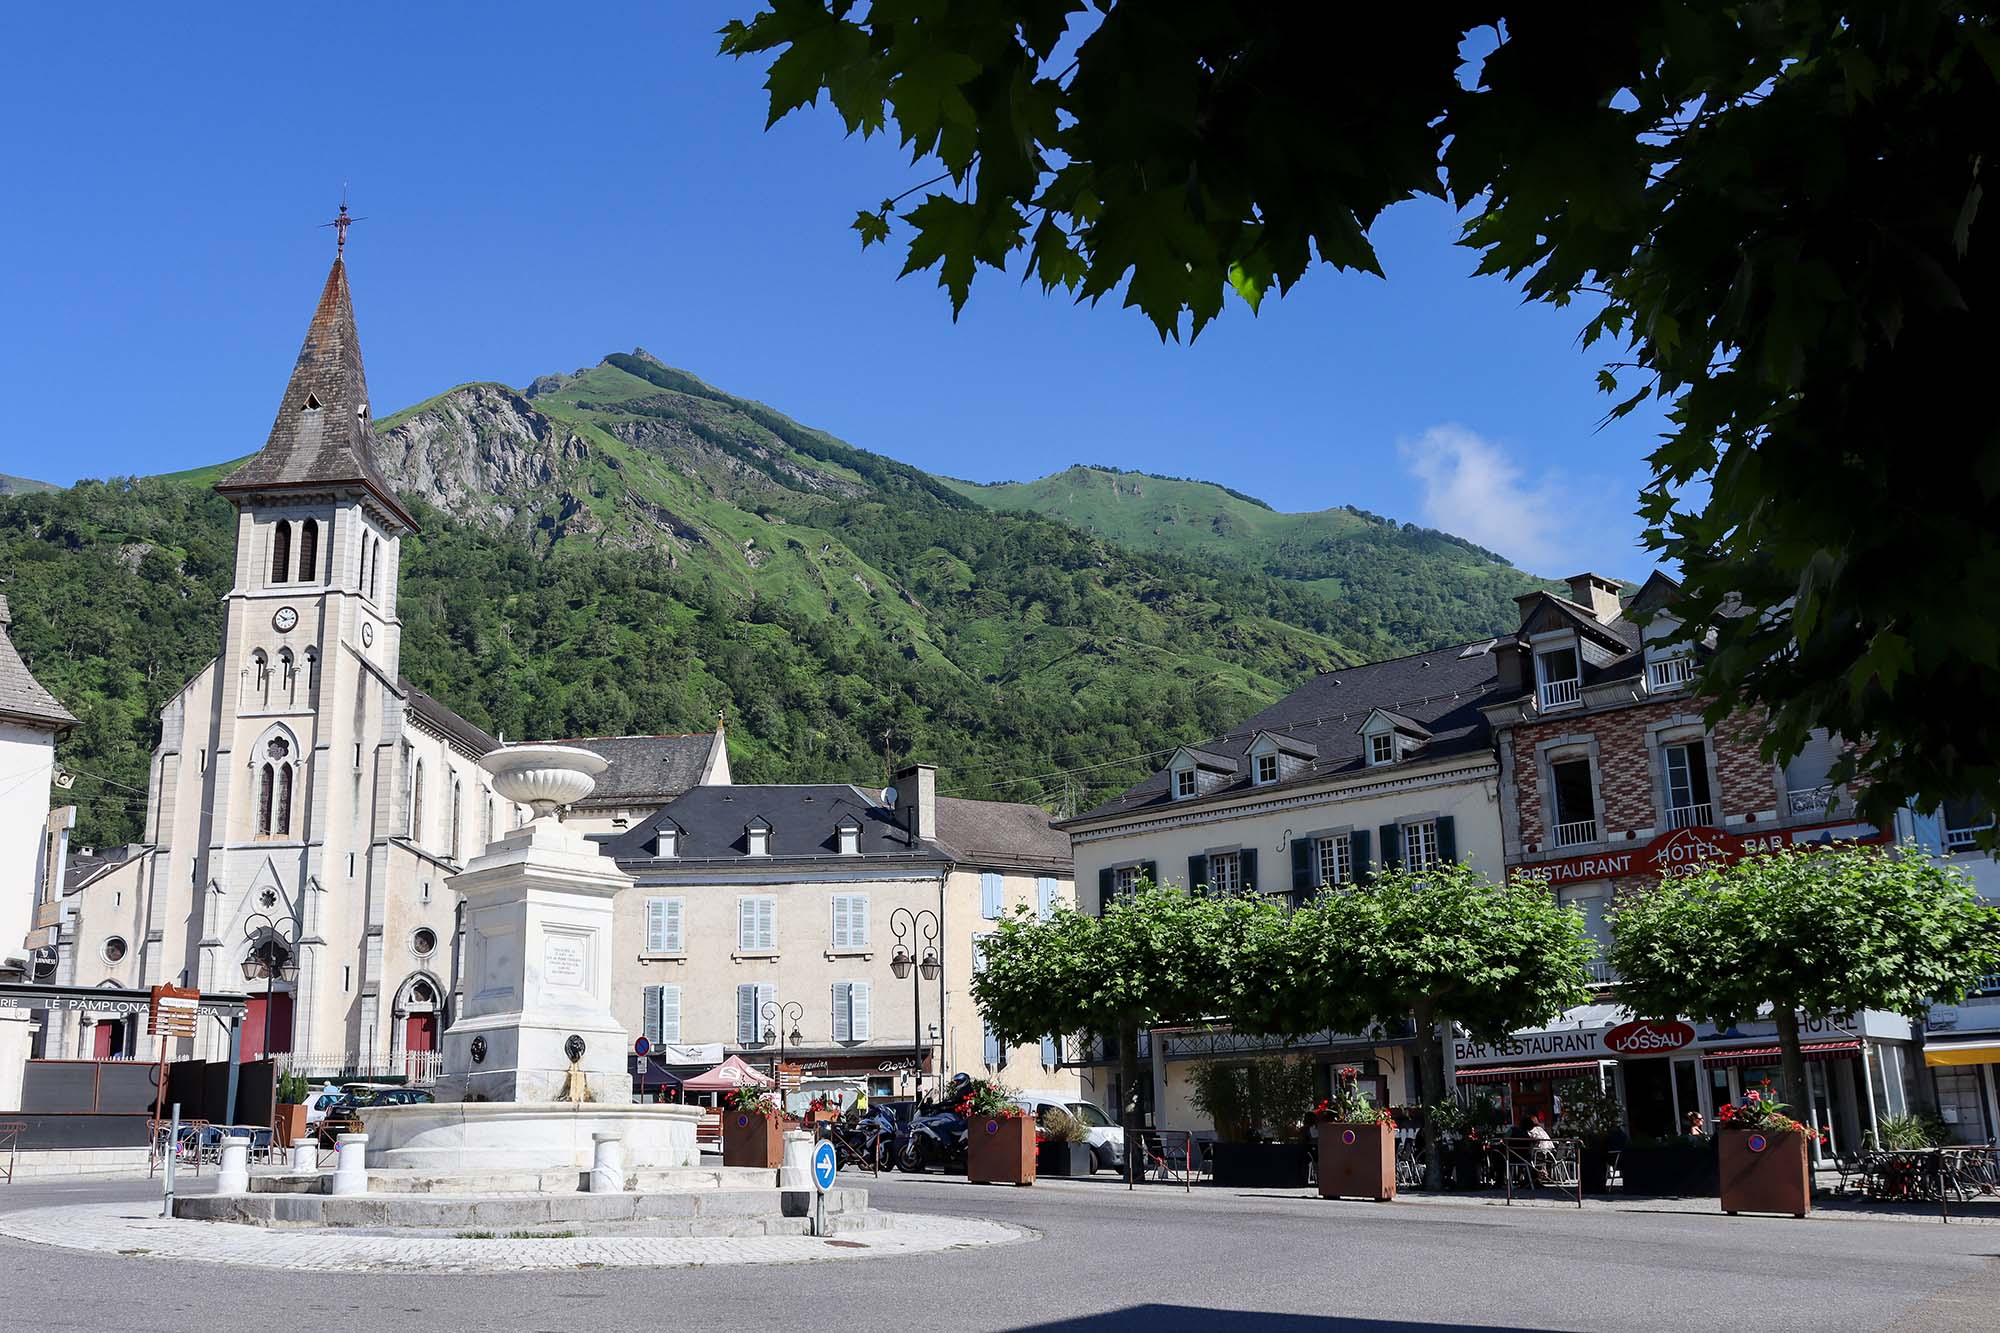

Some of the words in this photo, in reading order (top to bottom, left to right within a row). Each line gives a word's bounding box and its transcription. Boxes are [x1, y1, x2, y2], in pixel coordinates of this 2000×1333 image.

[1520, 855, 1632, 881] RESTAURANT
[1744, 836, 1782, 855] BAR
[1657, 842, 1720, 863] HÔTEL
[69, 1000, 149, 1012] PAMPLONA
[1455, 1042, 1487, 1060] BAR
[1494, 1033, 1597, 1056] RESTAURANT
[1616, 1031, 1683, 1051] L'OSSAU
